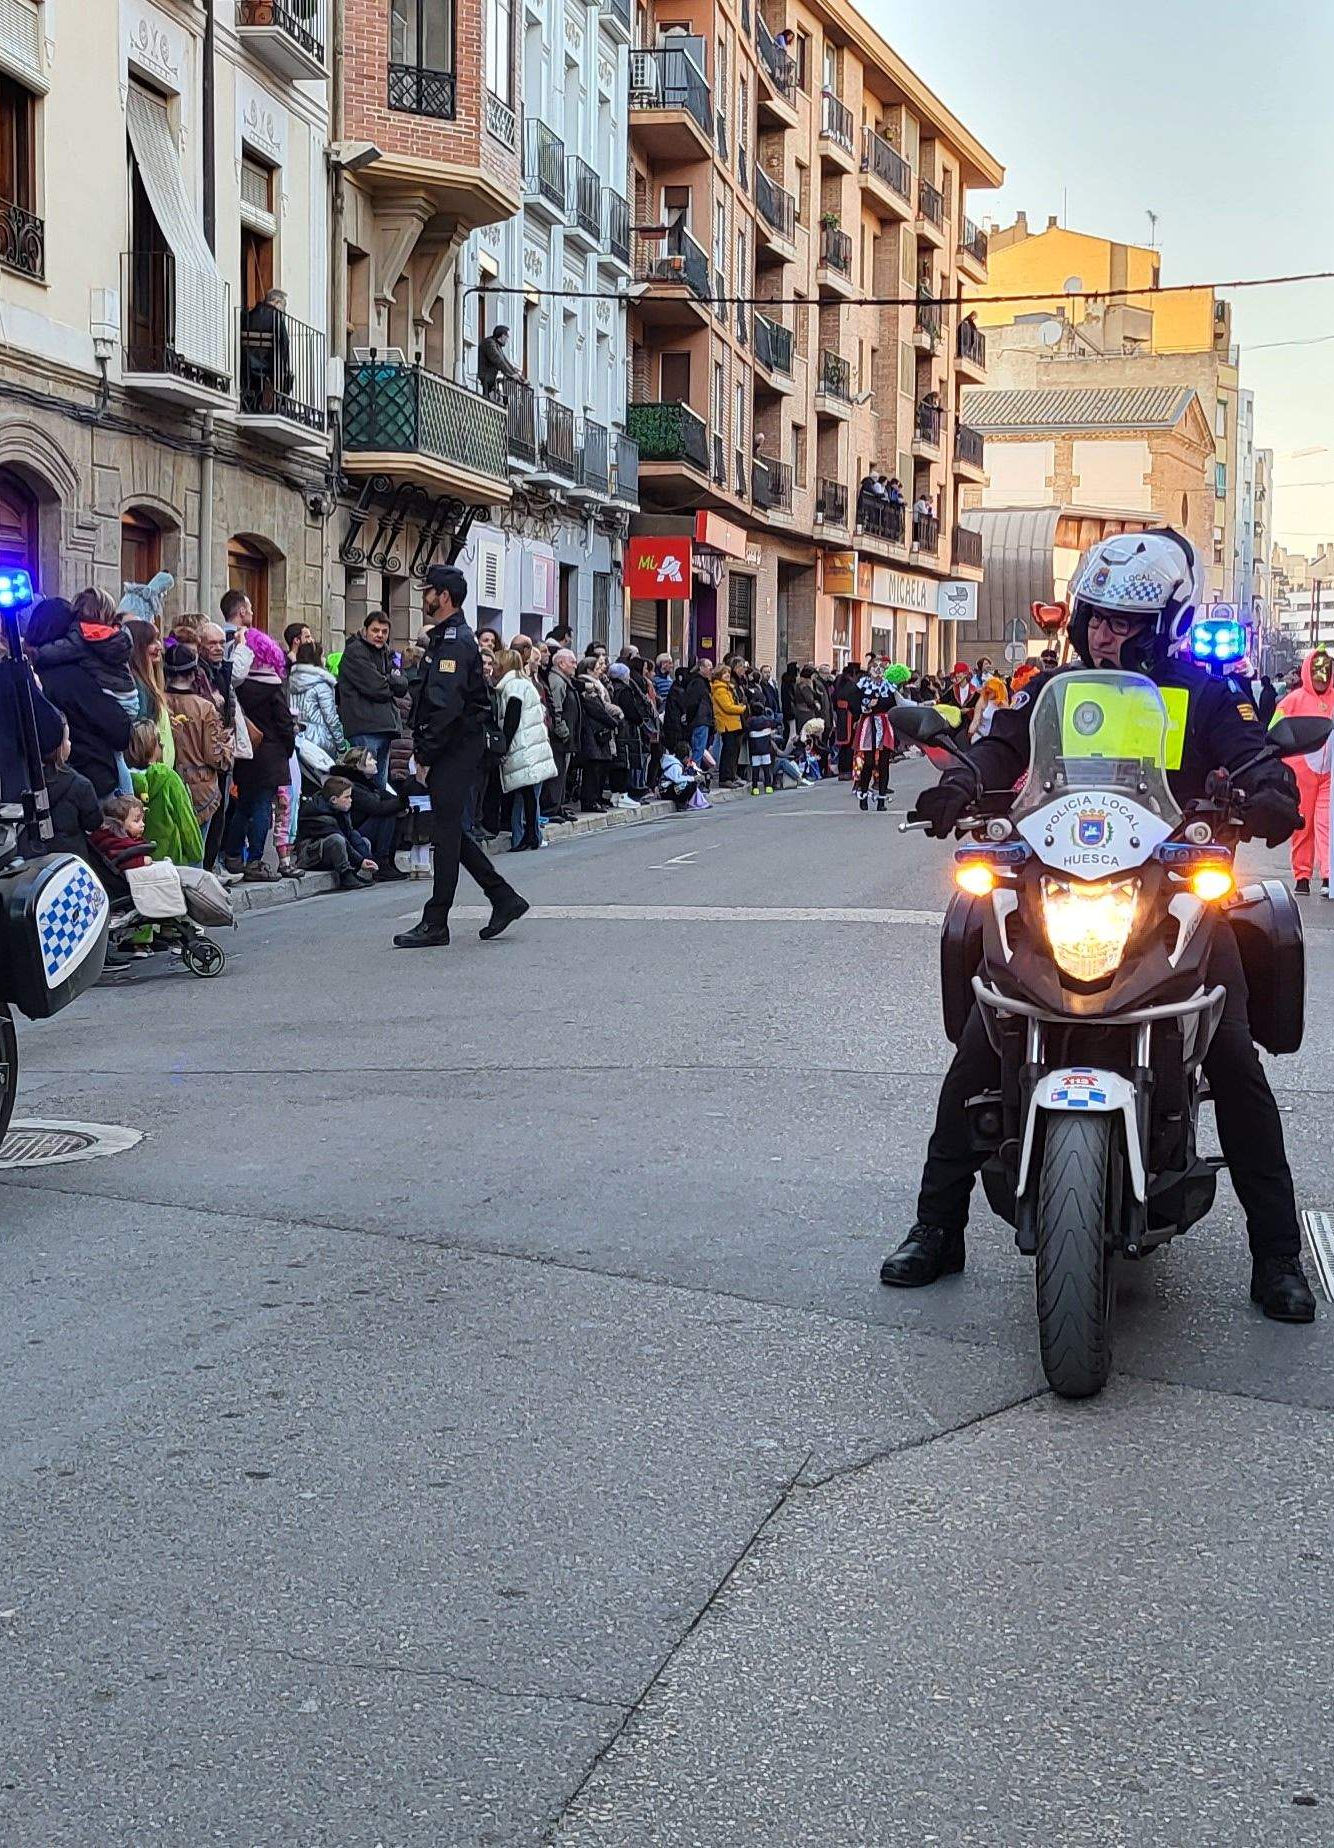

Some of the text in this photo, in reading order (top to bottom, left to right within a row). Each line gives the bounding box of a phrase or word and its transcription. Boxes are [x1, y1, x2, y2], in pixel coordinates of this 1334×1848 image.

[1123, 573, 1153, 583] LOCAL
[888, 573, 927, 608] MICAELA
[1045, 795, 1140, 833] POLICIA LOCAL
[1063, 853, 1120, 867] HUESCA
